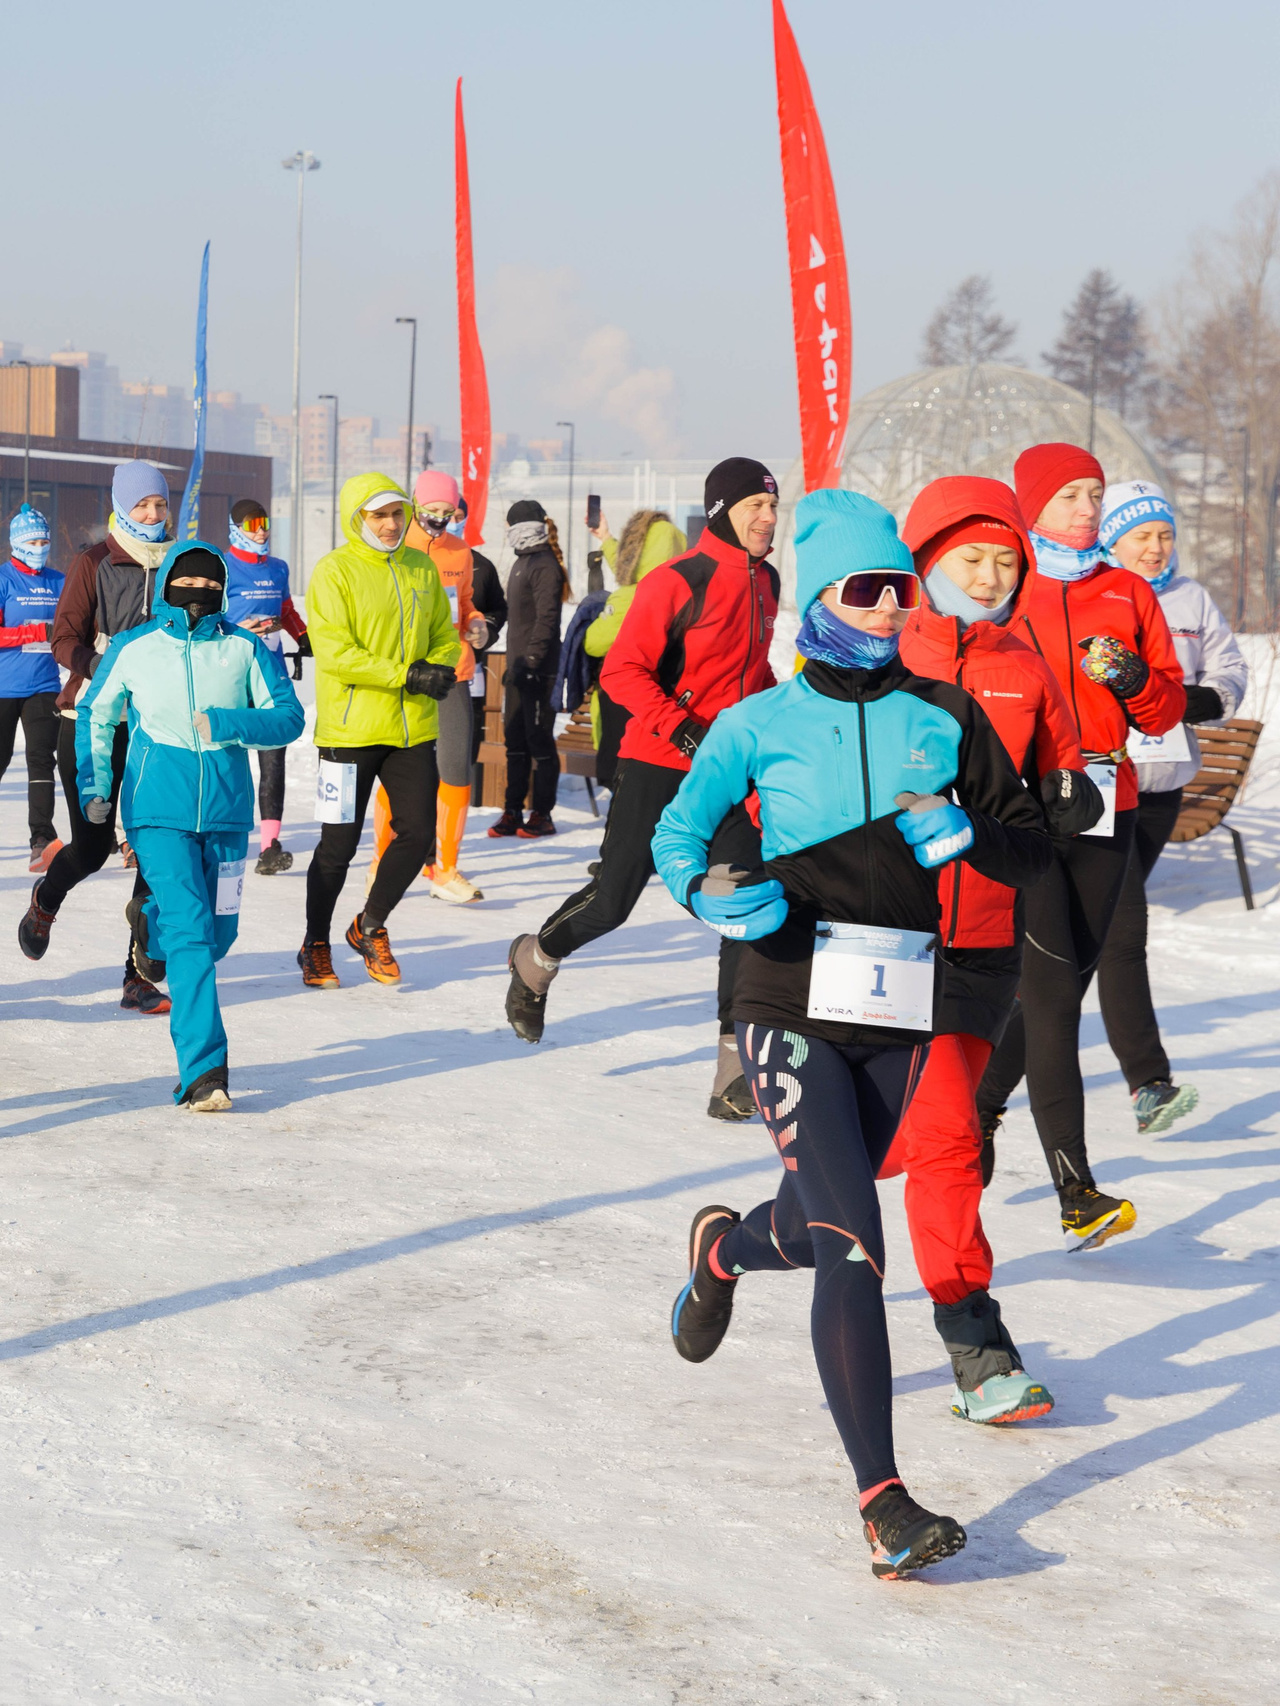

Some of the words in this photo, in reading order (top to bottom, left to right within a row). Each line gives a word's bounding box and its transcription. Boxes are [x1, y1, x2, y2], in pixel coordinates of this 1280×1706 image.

[119, 514, 150, 540] VIRA
[324, 782, 339, 803] 61
[925, 825, 972, 863] YOKO
[870, 964, 887, 998] 1
[826, 1007, 854, 1016] VIRA
[862, 1011, 883, 1020] Альфа
[883, 1012, 898, 1021] Банк
